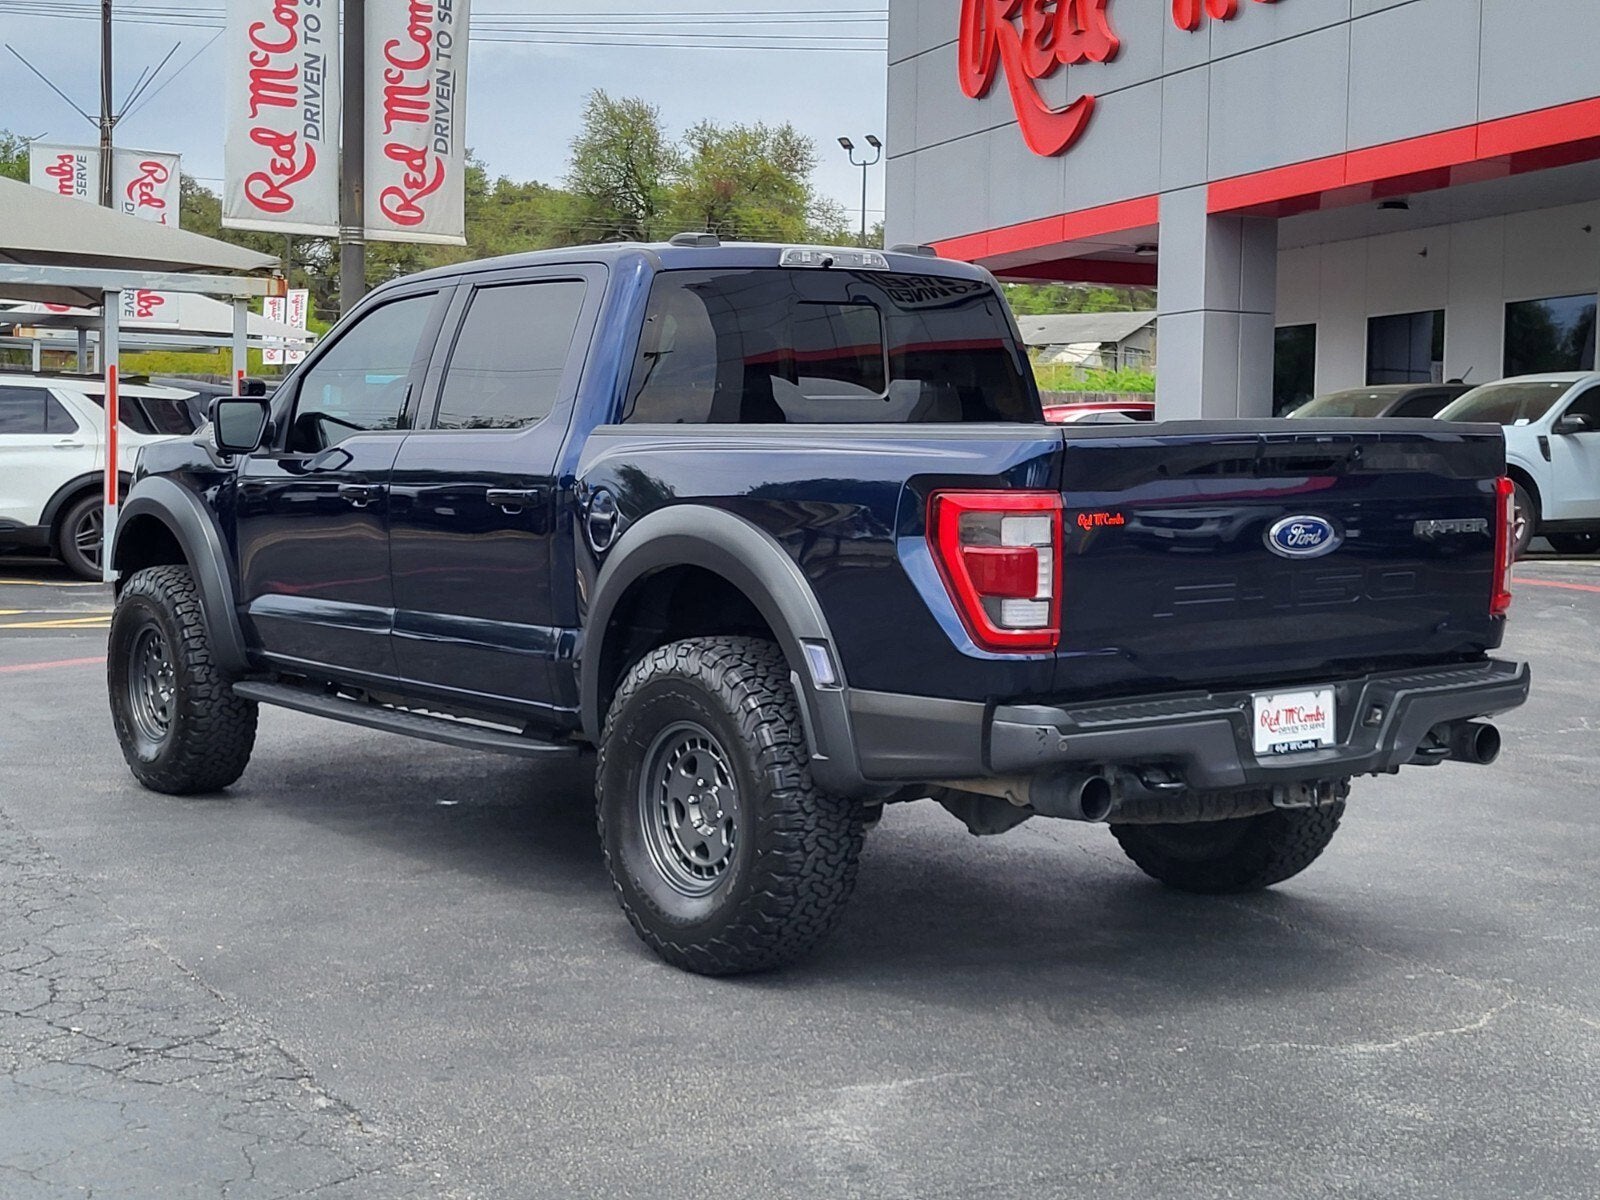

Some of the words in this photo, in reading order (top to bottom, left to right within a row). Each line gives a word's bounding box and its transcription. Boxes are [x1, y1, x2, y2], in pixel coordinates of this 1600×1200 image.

[303, 14, 321, 44] TO
[436, 30, 453, 61] TO
[303, 52, 320, 141] DRIVEN
[434, 68, 452, 155] DRIVEN
[76, 154, 87, 196] SERVE
[127, 160, 169, 209] Red
[244, 127, 317, 213] Red
[379, 143, 446, 226] Red
[1077, 513, 1093, 531] Red
[1286, 523, 1323, 547] Ford
[1413, 518, 1491, 540] RAPTOR
[1260, 709, 1281, 733] Red
[1281, 705, 1326, 725] McCombs
